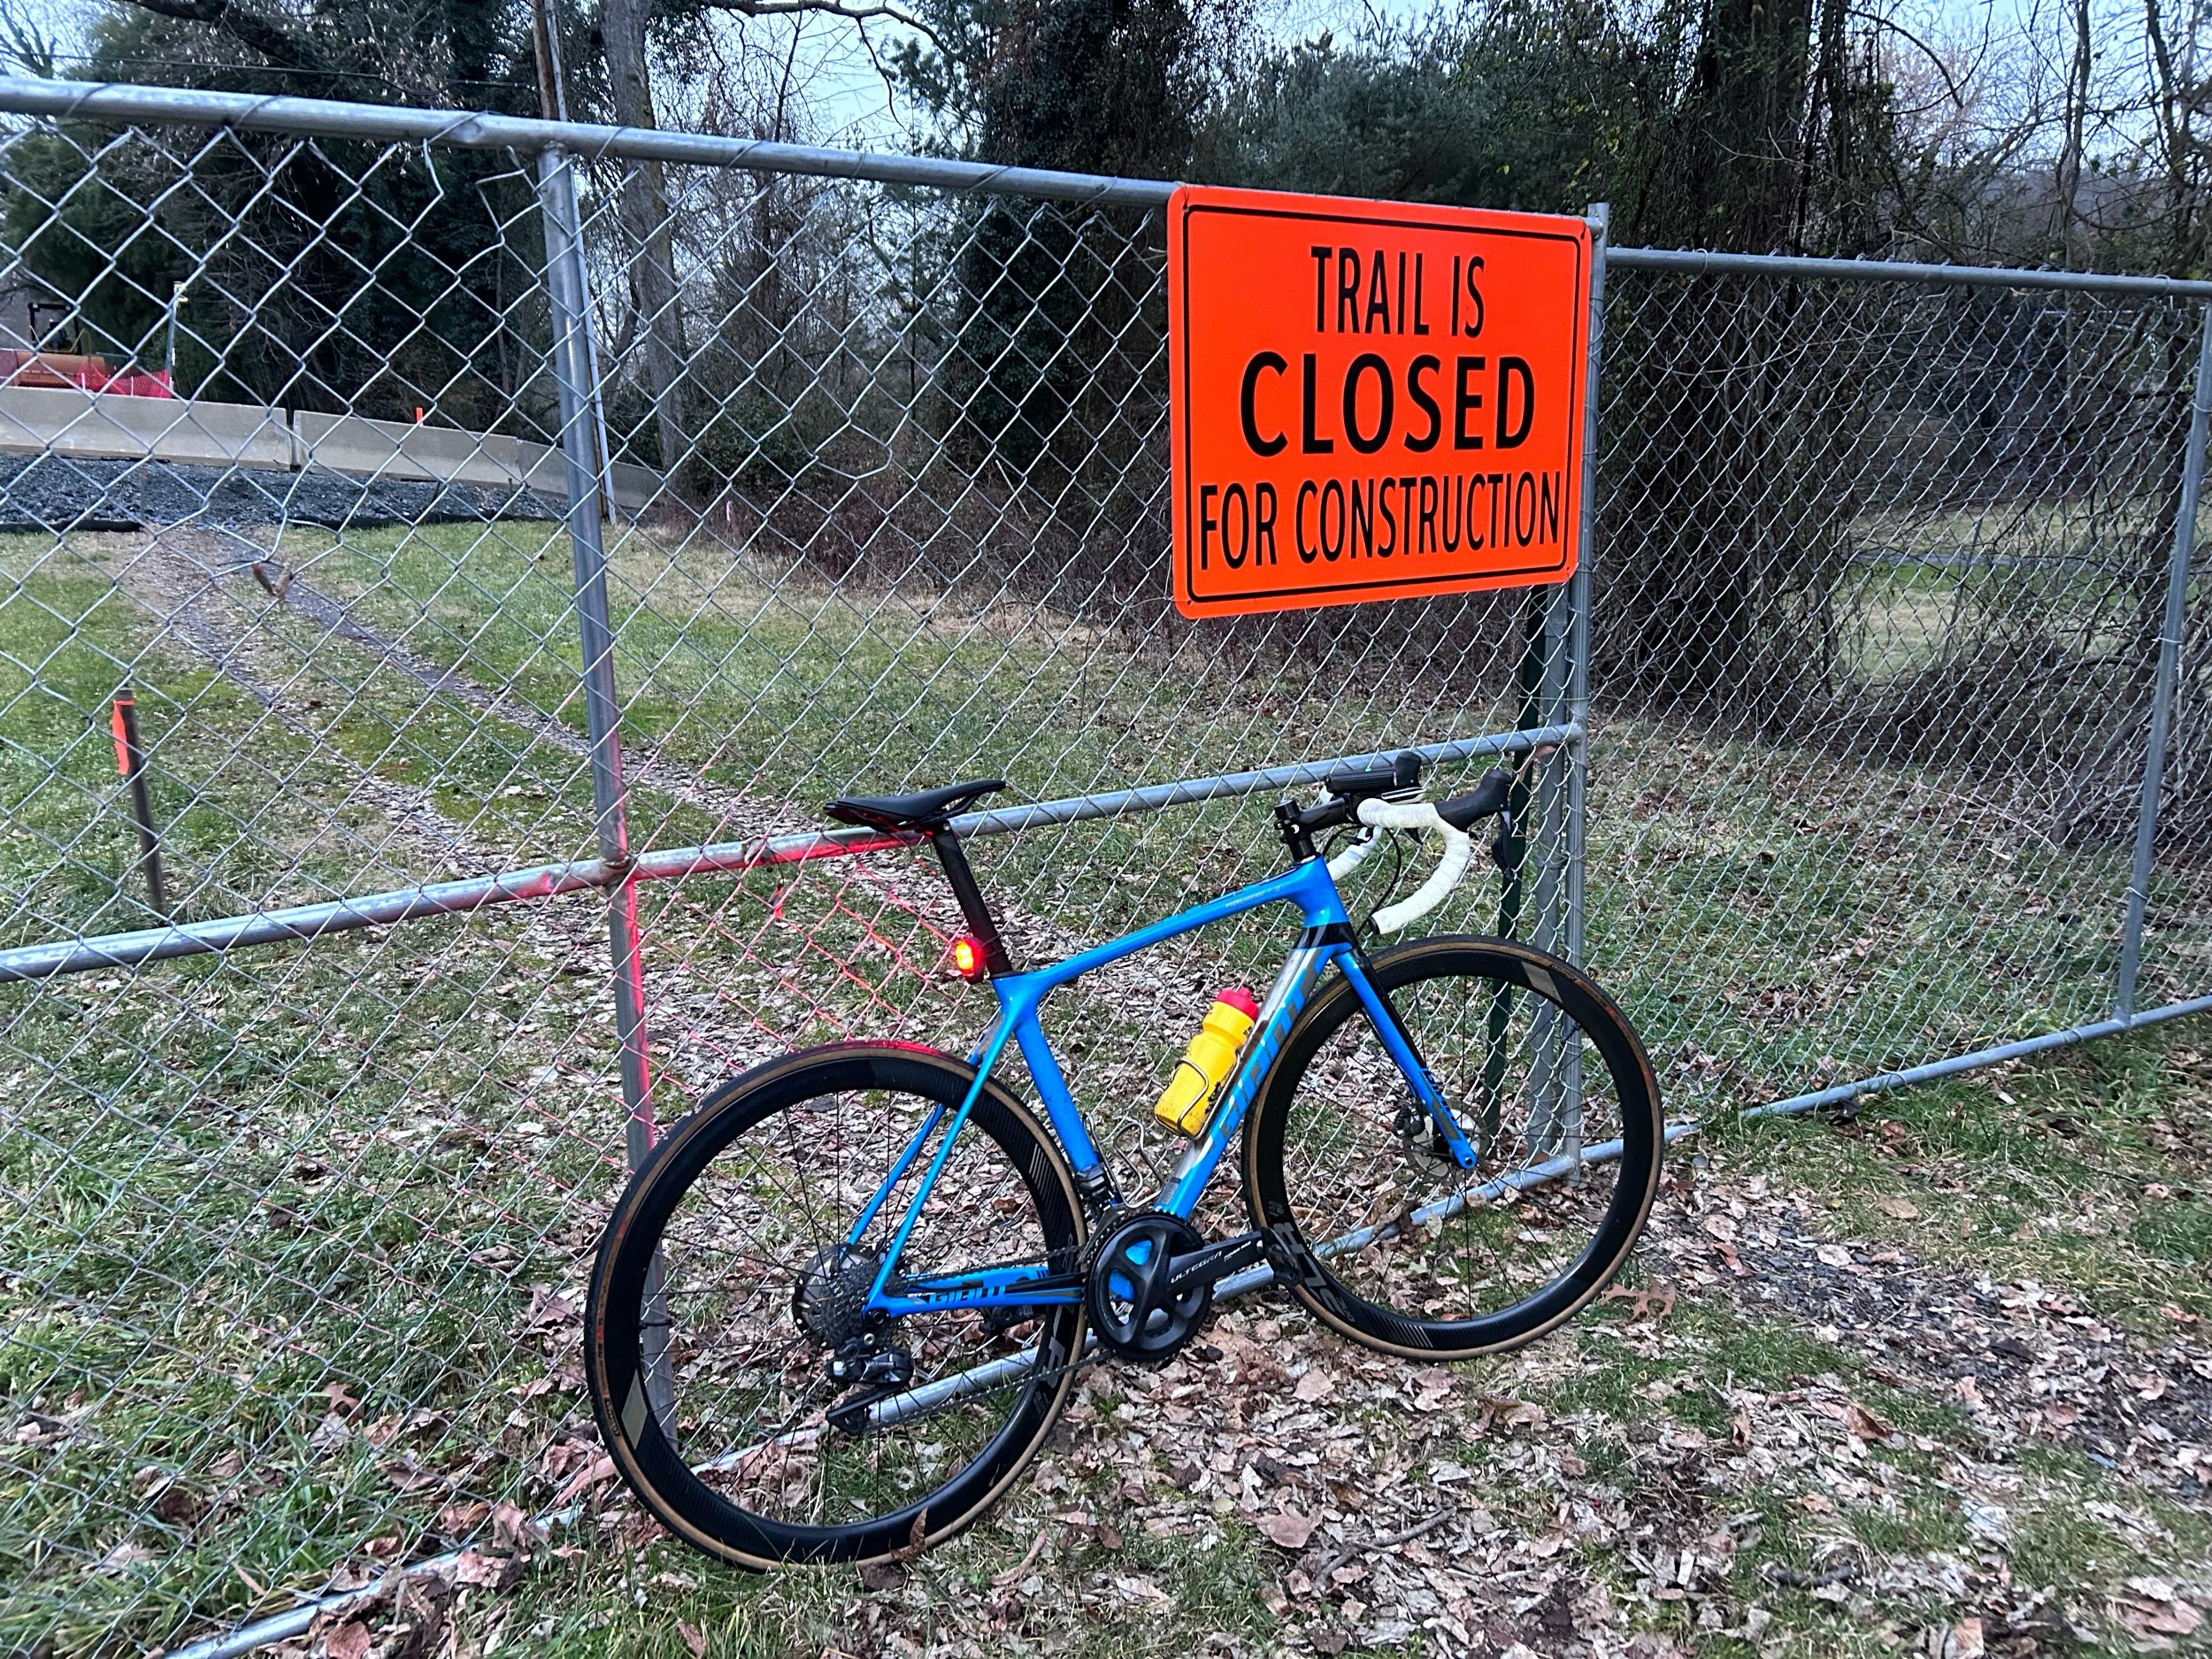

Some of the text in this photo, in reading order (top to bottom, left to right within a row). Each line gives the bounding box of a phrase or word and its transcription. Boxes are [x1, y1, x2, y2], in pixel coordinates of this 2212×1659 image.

[1310, 246, 1485, 338] TRAIL IS
[1240, 351, 1535, 457] CLOSED
[1200, 471, 1560, 570] FOR CONSTRUCTION
[1211, 968, 1307, 1150] GIANT
[1171, 1250, 1223, 1284] ULTEGRA
